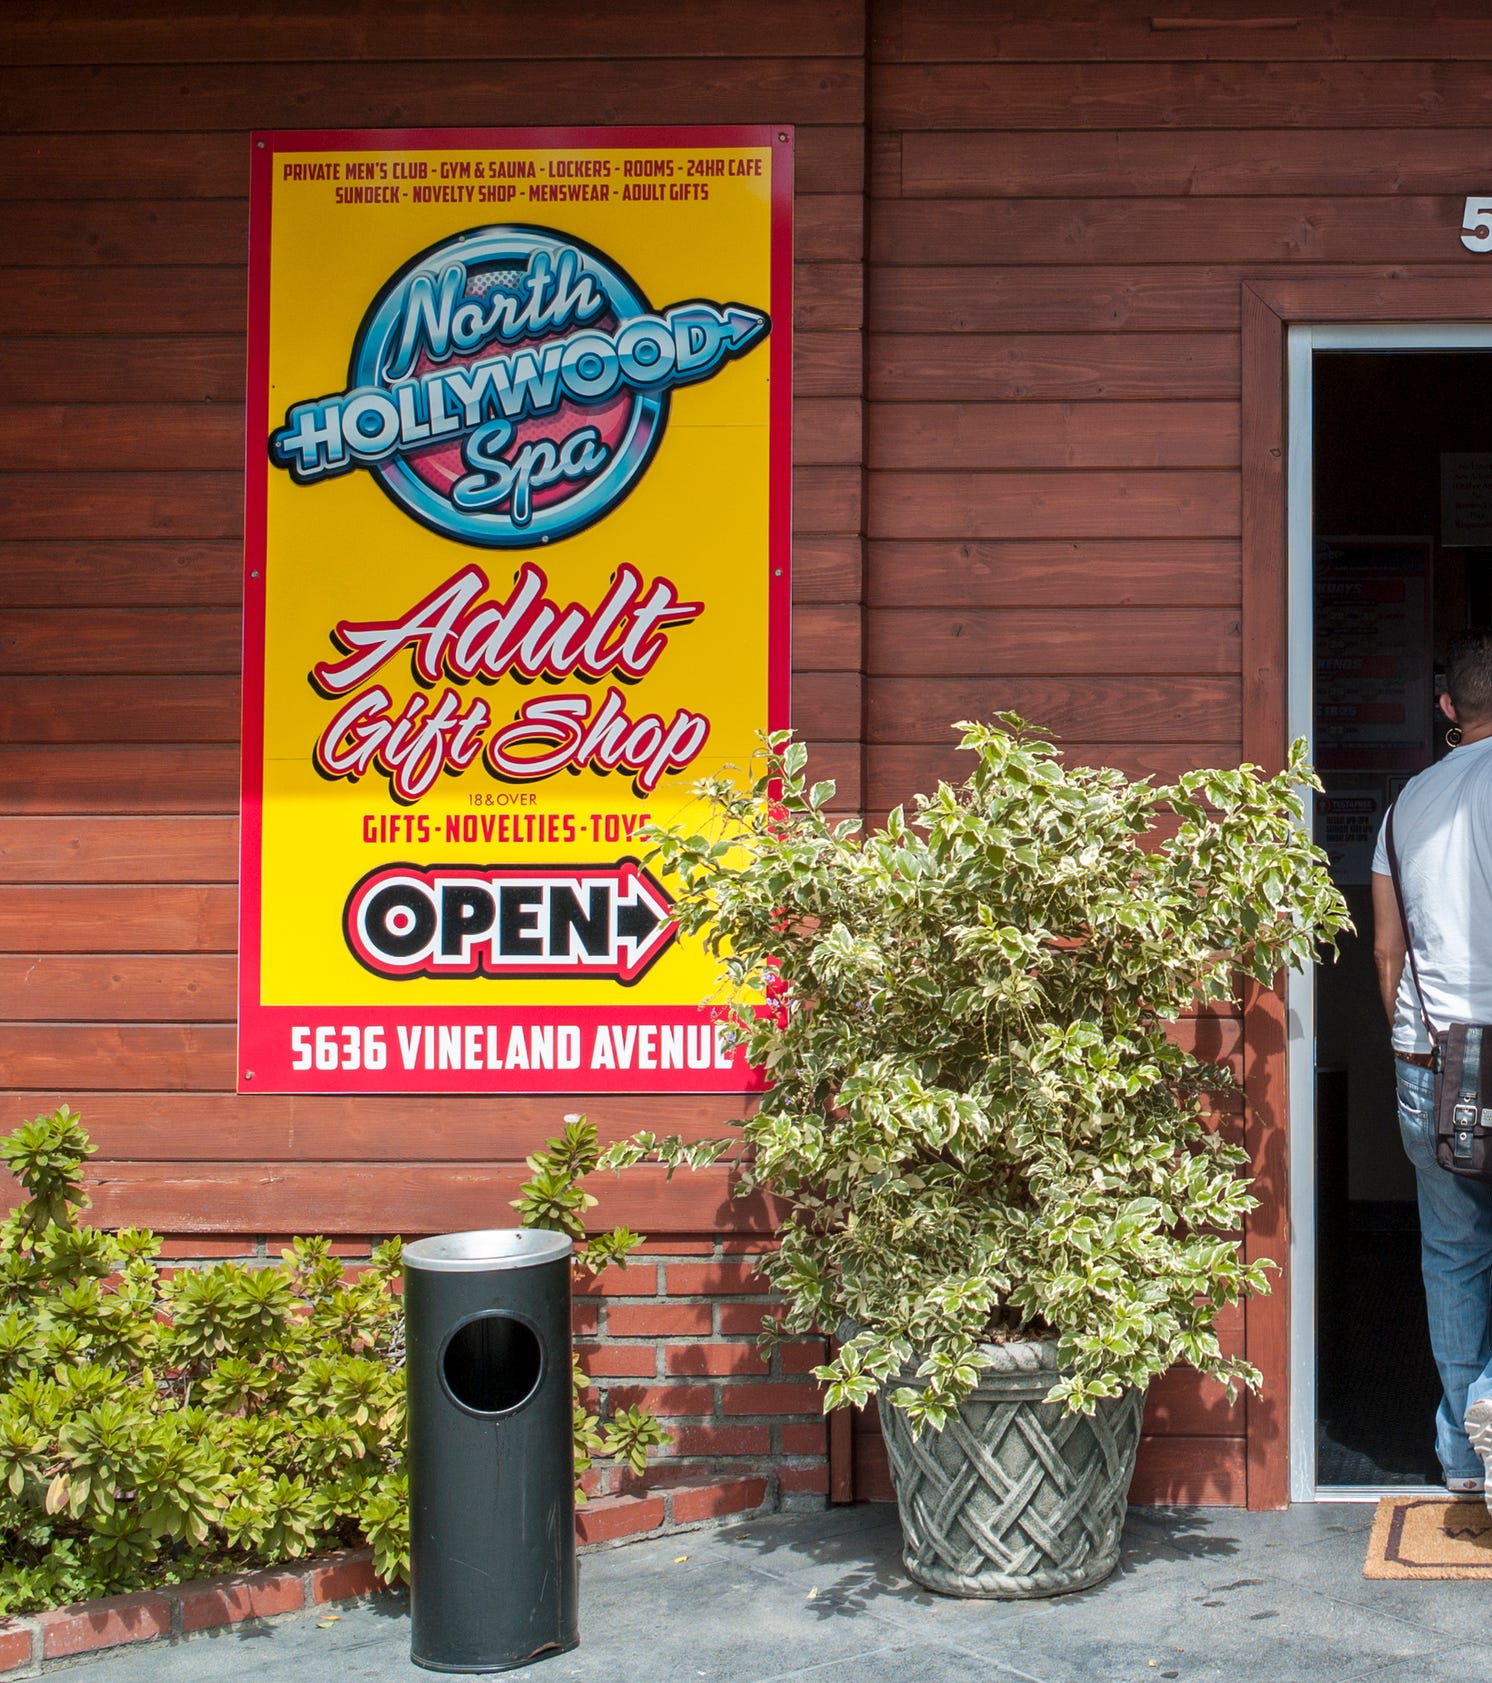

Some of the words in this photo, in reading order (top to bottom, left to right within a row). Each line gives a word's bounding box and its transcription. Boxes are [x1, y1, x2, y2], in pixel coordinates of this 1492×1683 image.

[283, 163, 341, 181] PRIVATE
[345, 162, 388, 180] MEN'S
[392, 162, 428, 180] CLUB
[440, 161, 471, 179] GYM
[474, 161, 485, 179] &
[488, 161, 536, 179] SAUNA
[548, 160, 611, 178] LOCKERS
[623, 159, 674, 178] ROOMS
[687, 159, 725, 177] 24HR
[728, 159, 762, 177] CAFE
[335, 186, 400, 204] SUNDECK
[412, 185, 475, 203] NOVELTY
[478, 184, 516, 203] SHOP
[528, 184, 610, 202] MENSWEAR
[622, 183, 666, 201] ADULT
[669, 183, 709, 201] GIFTS
[382, 246, 603, 384] North
[283, 308, 722, 475] HOLLYWOOD
[453, 420, 608, 526] Spa
[314, 562, 705, 692] Adult
[317, 684, 491, 802] Gift
[486, 686, 711, 793] Shop
[361, 880, 613, 961] OPEN
[291, 1025, 387, 1071] 5636
[396, 1025, 581, 1071] VINELAND
[590, 1024, 734, 1070] AVENUE
